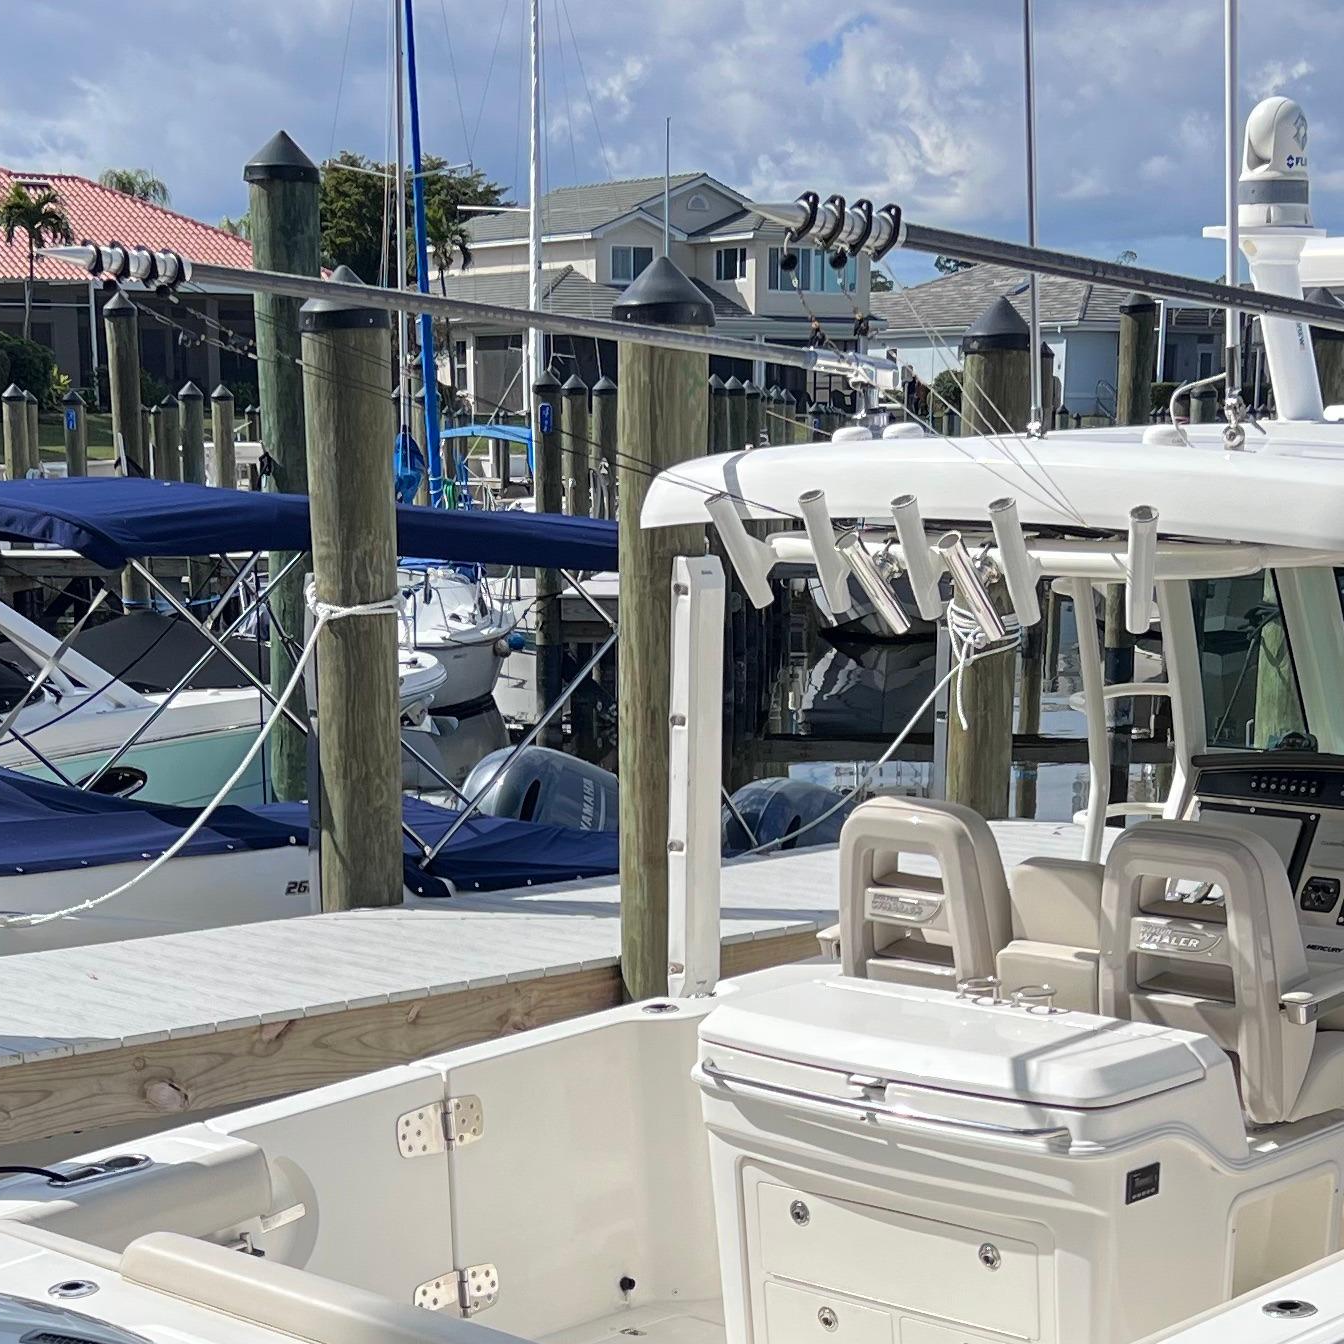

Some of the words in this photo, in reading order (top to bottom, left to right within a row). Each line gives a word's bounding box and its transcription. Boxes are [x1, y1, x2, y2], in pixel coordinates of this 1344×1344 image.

[579, 776, 595, 832] YAMAHA
[285, 879, 310, 896] 26
[1138, 931, 1201, 949] WHALER
[1306, 943, 1344, 953] MERCURY
